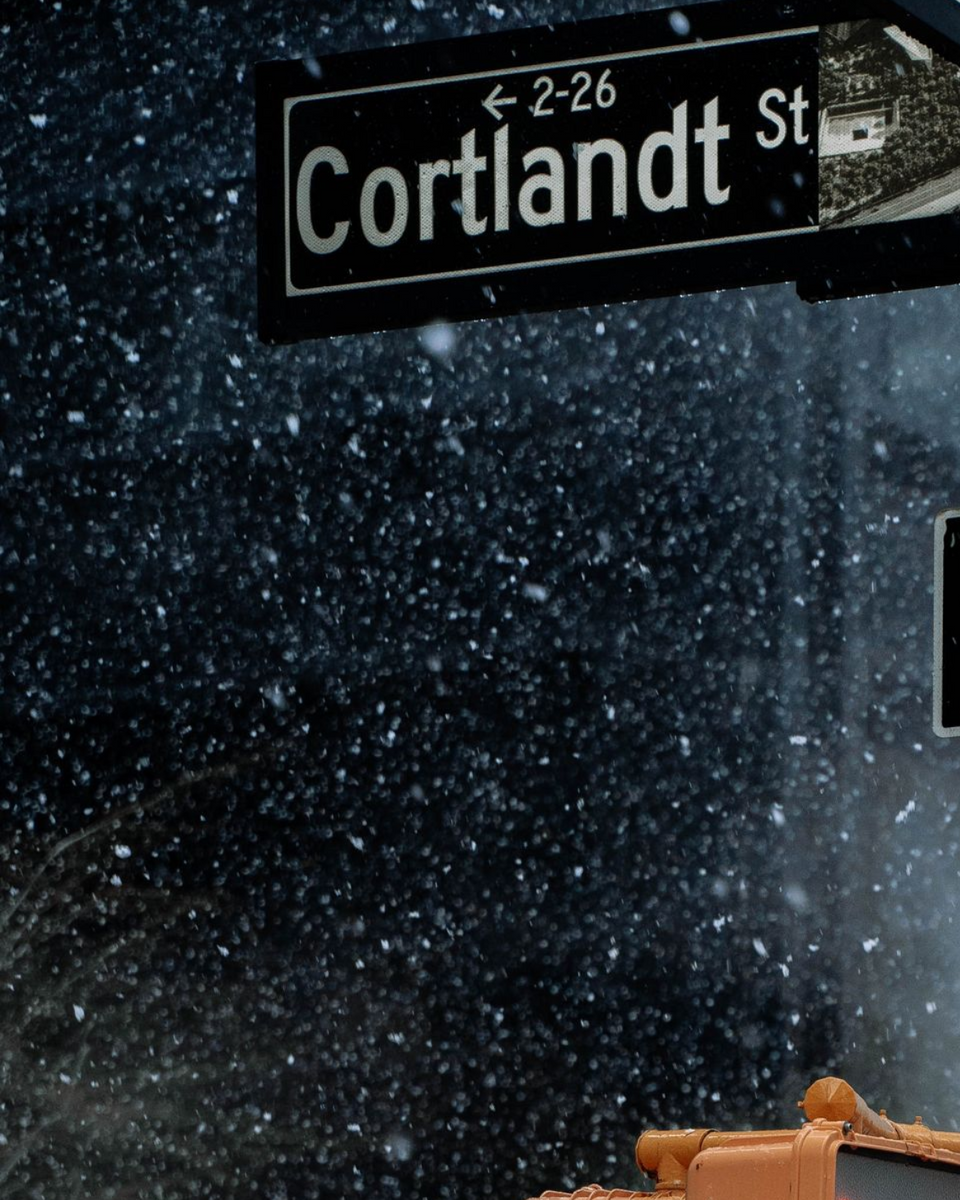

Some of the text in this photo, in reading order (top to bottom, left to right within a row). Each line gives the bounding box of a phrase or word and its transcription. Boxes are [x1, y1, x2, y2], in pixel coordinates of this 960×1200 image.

[532, 68, 617, 118] 2-26
[296, 85, 810, 255] Cortlandt St
